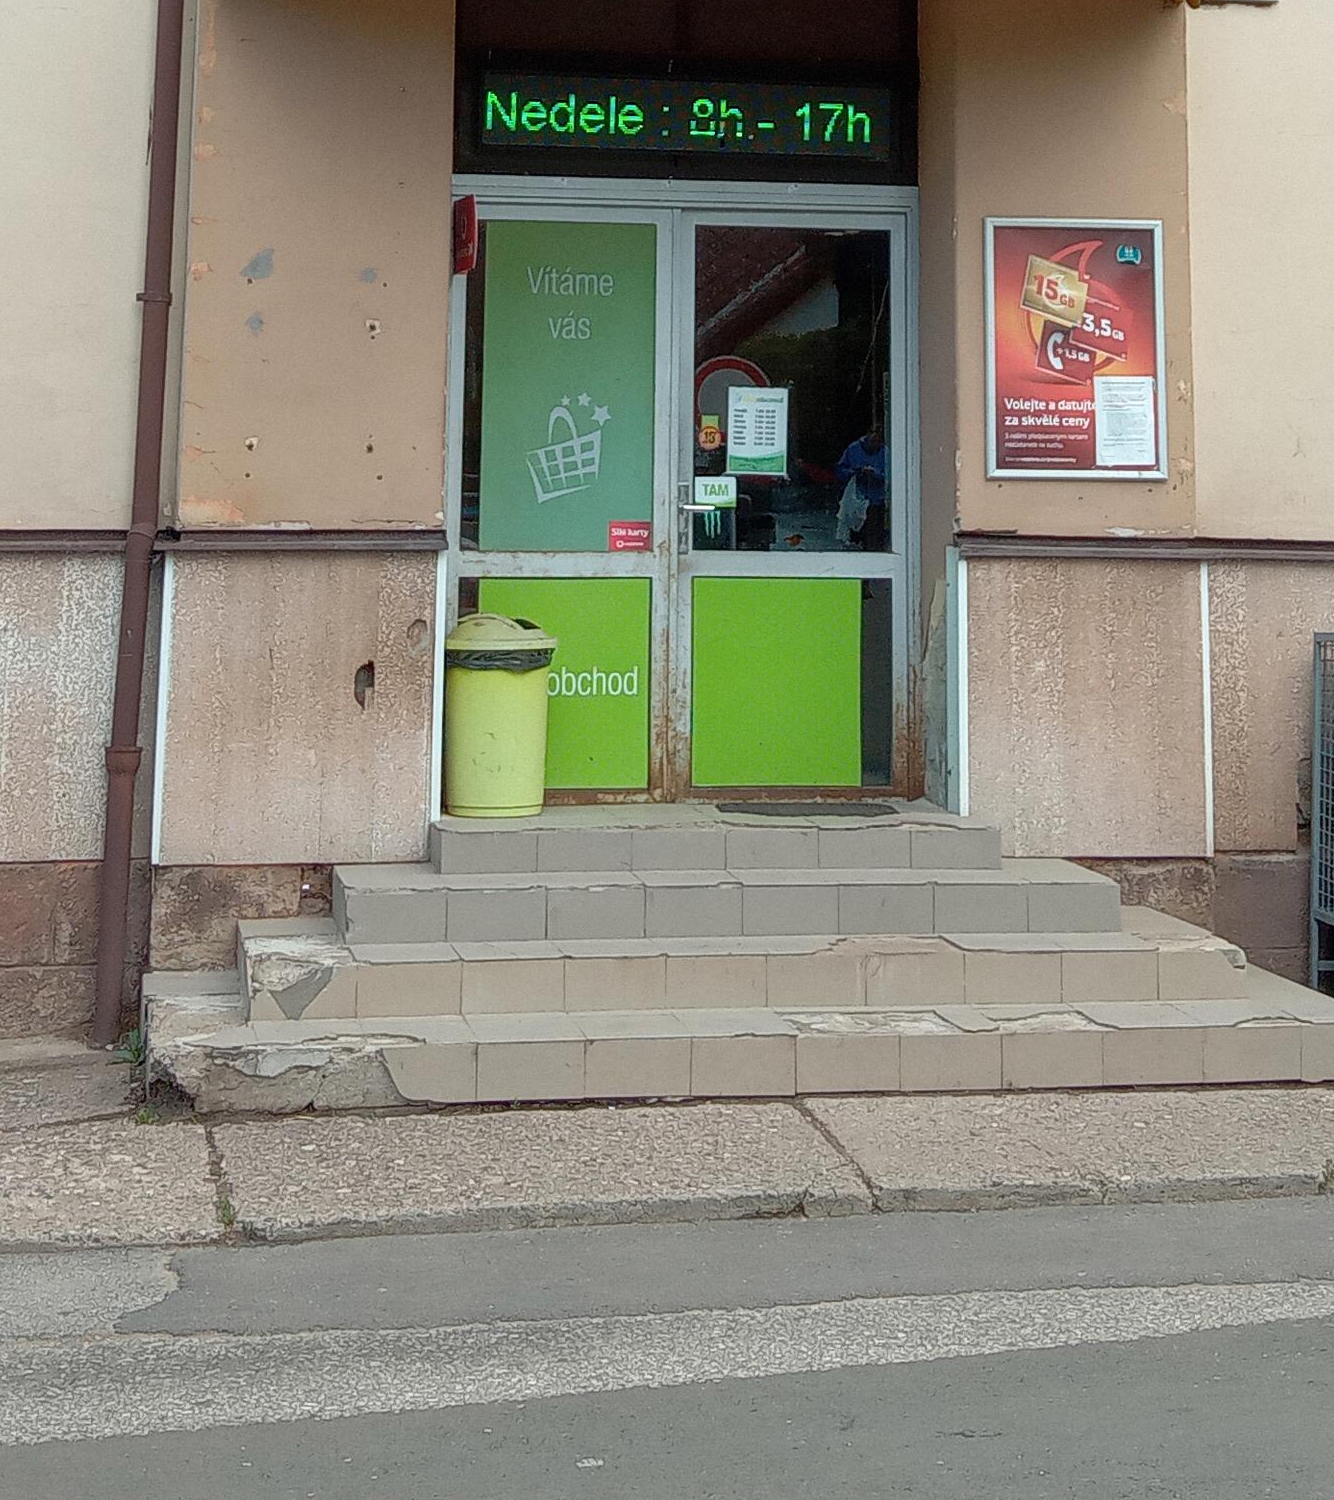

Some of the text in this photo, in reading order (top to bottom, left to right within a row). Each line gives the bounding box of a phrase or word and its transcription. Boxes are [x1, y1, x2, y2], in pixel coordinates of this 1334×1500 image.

[485, 91, 644, 136] Nedele
[795, 101, 872, 143] 17h
[527, 266, 614, 297] Vítáme
[1034, 274, 1059, 301] 15
[548, 310, 591, 340] vás
[1003, 397, 1047, 413] Volejte
[1048, 400, 1057, 411] a
[1004, 412, 1091, 429] za skvělé ceny
[701, 483, 729, 497] TAM
